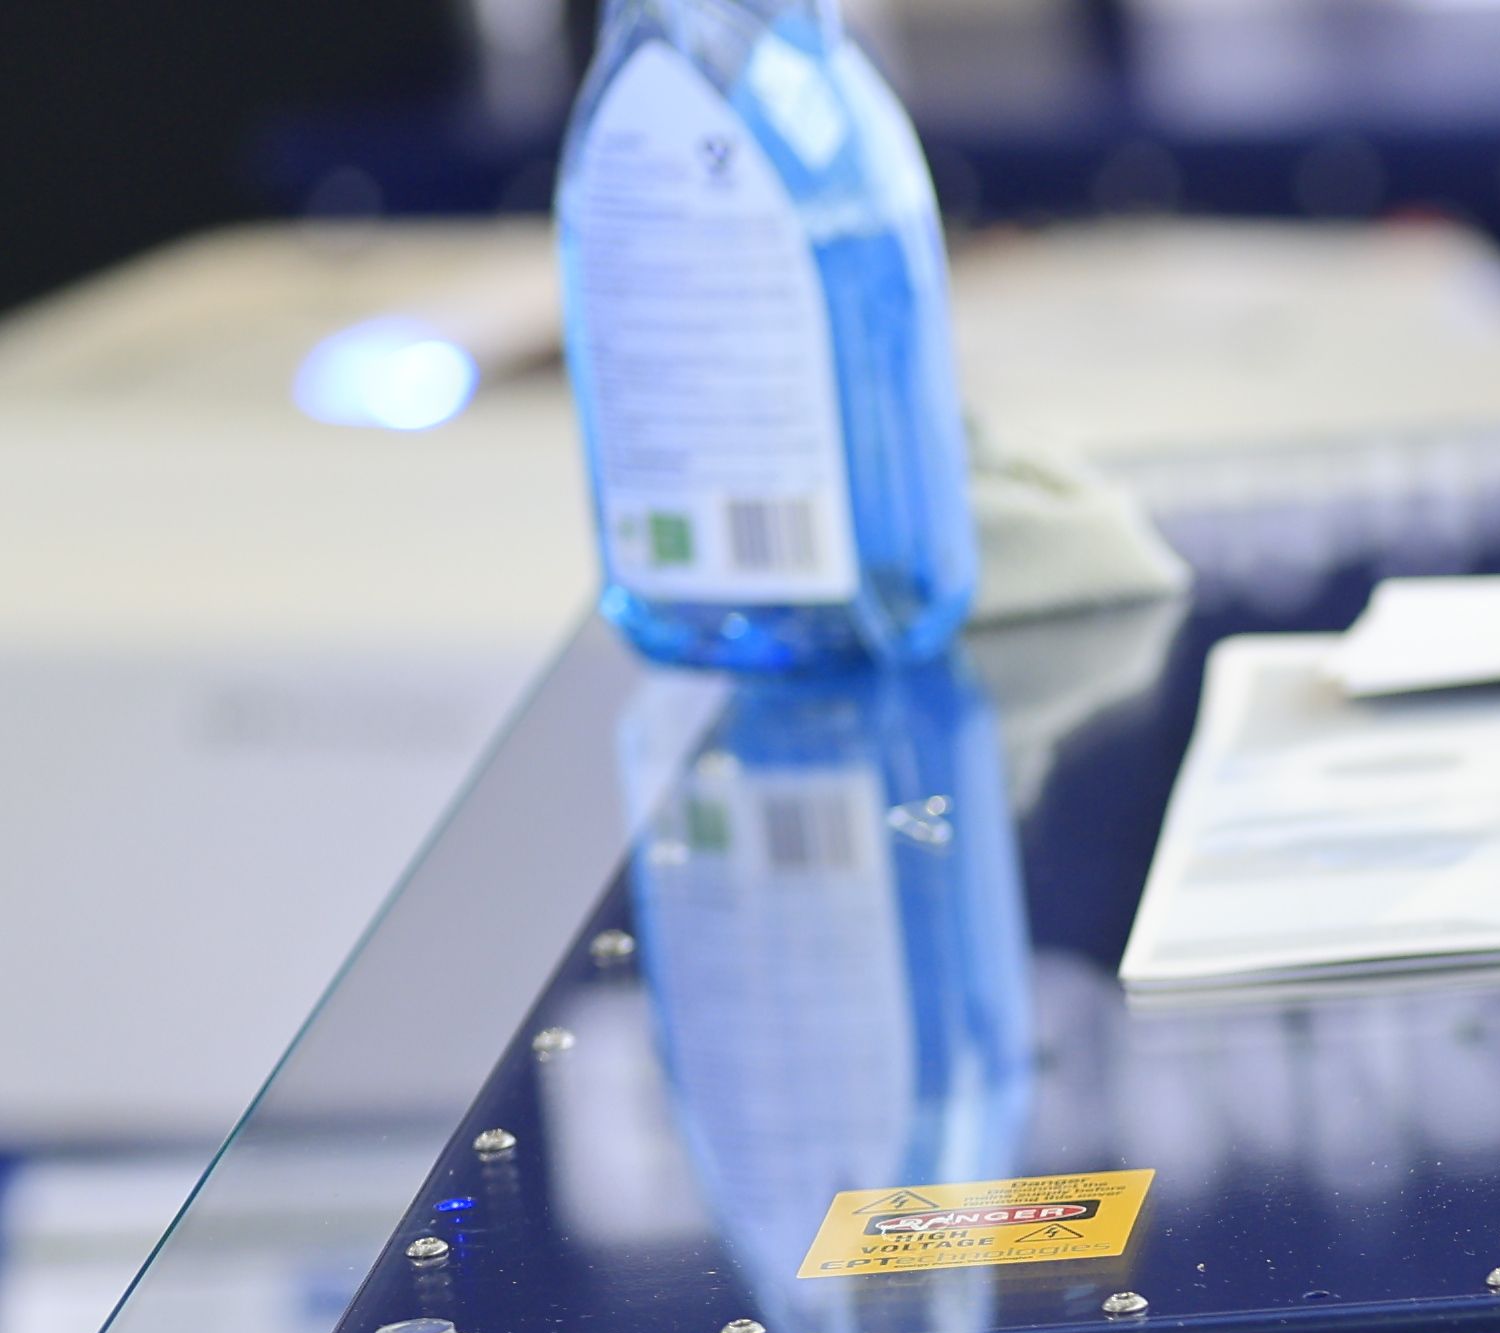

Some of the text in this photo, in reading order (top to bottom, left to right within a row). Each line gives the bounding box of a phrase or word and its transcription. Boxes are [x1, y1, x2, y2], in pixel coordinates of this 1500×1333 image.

[894, 1229, 969, 1243] HIGH
[820, 1241, 1110, 1271] EPTechnologies
[862, 1237, 994, 1256] VOLTAGE
